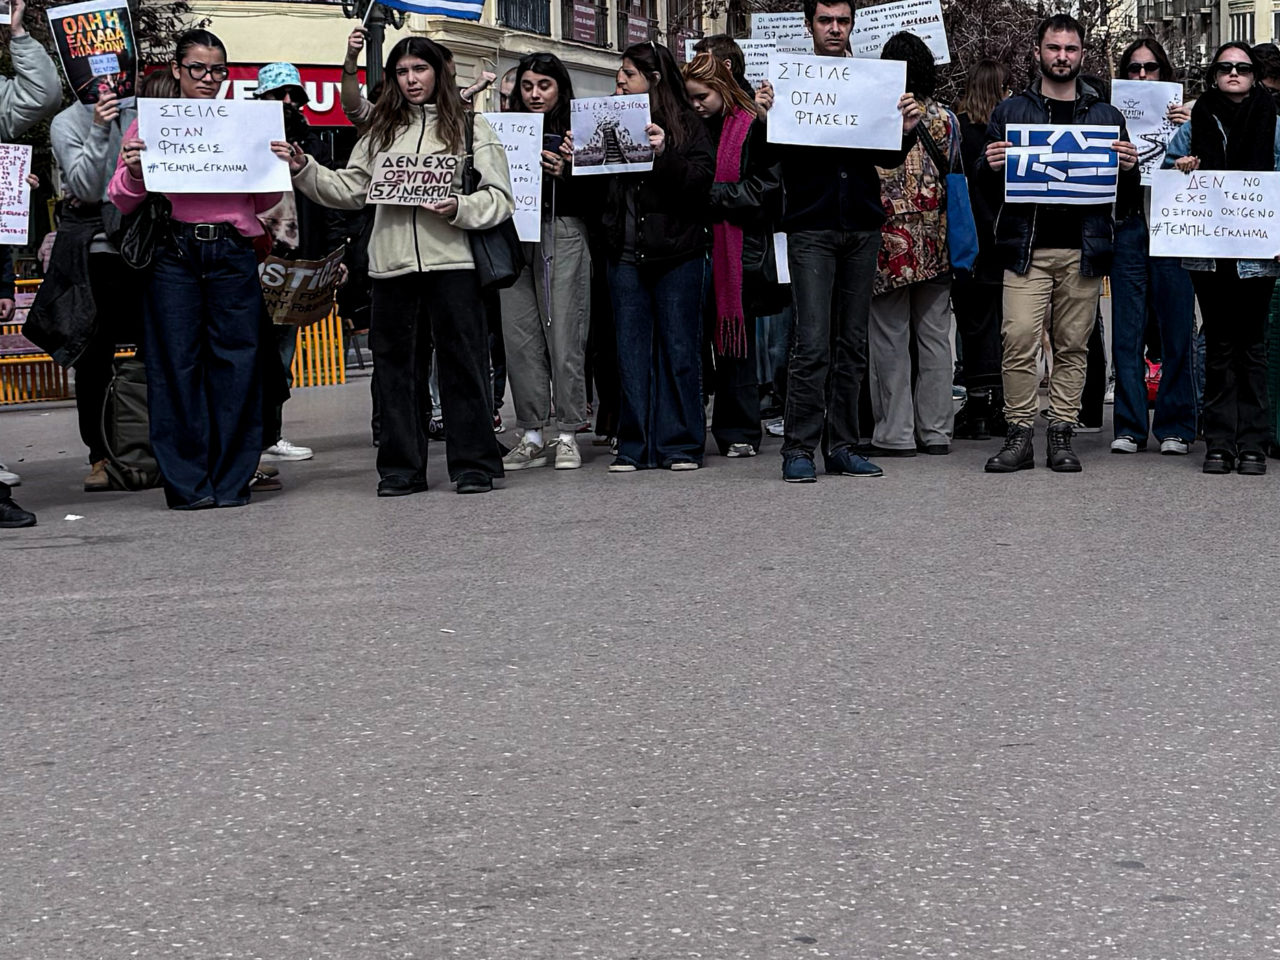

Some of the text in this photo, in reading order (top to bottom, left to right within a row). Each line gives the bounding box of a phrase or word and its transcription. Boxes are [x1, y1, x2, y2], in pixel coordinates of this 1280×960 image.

[66, 27, 126, 50] ΕΛΛΑΔΑ
[778, 62, 851, 81] ΣΤΕΙΛΕ
[791, 90, 837, 106] ΟΤΑΝ
[160, 104, 229, 118] ΣΤΕΙΛΕ
[795, 110, 859, 126] ΦΤΑΣΕΙΣ
[160, 126, 203, 138] ΟΤΑΝ
[511, 123, 535, 137] ΤΟΥΣ
[158, 140, 224, 155] ΦΤΑΣΕΙΣ
[381, 155, 458, 170] ΔΕΝ ΕΧΩ
[383, 169, 454, 185] ΟΞΥΓΟΝΟ
[1186, 174, 1225, 190] ΔΕΝ
[1243, 177, 1260, 187] NO
[373, 183, 449, 198] 57 ΝΕΚΡΟΙ
[1224, 191, 1263, 202] TENGO
[1175, 193, 1207, 204] ΕΧΩ
[1161, 207, 1213, 218] ΟΞΥΓΟΝΟ
